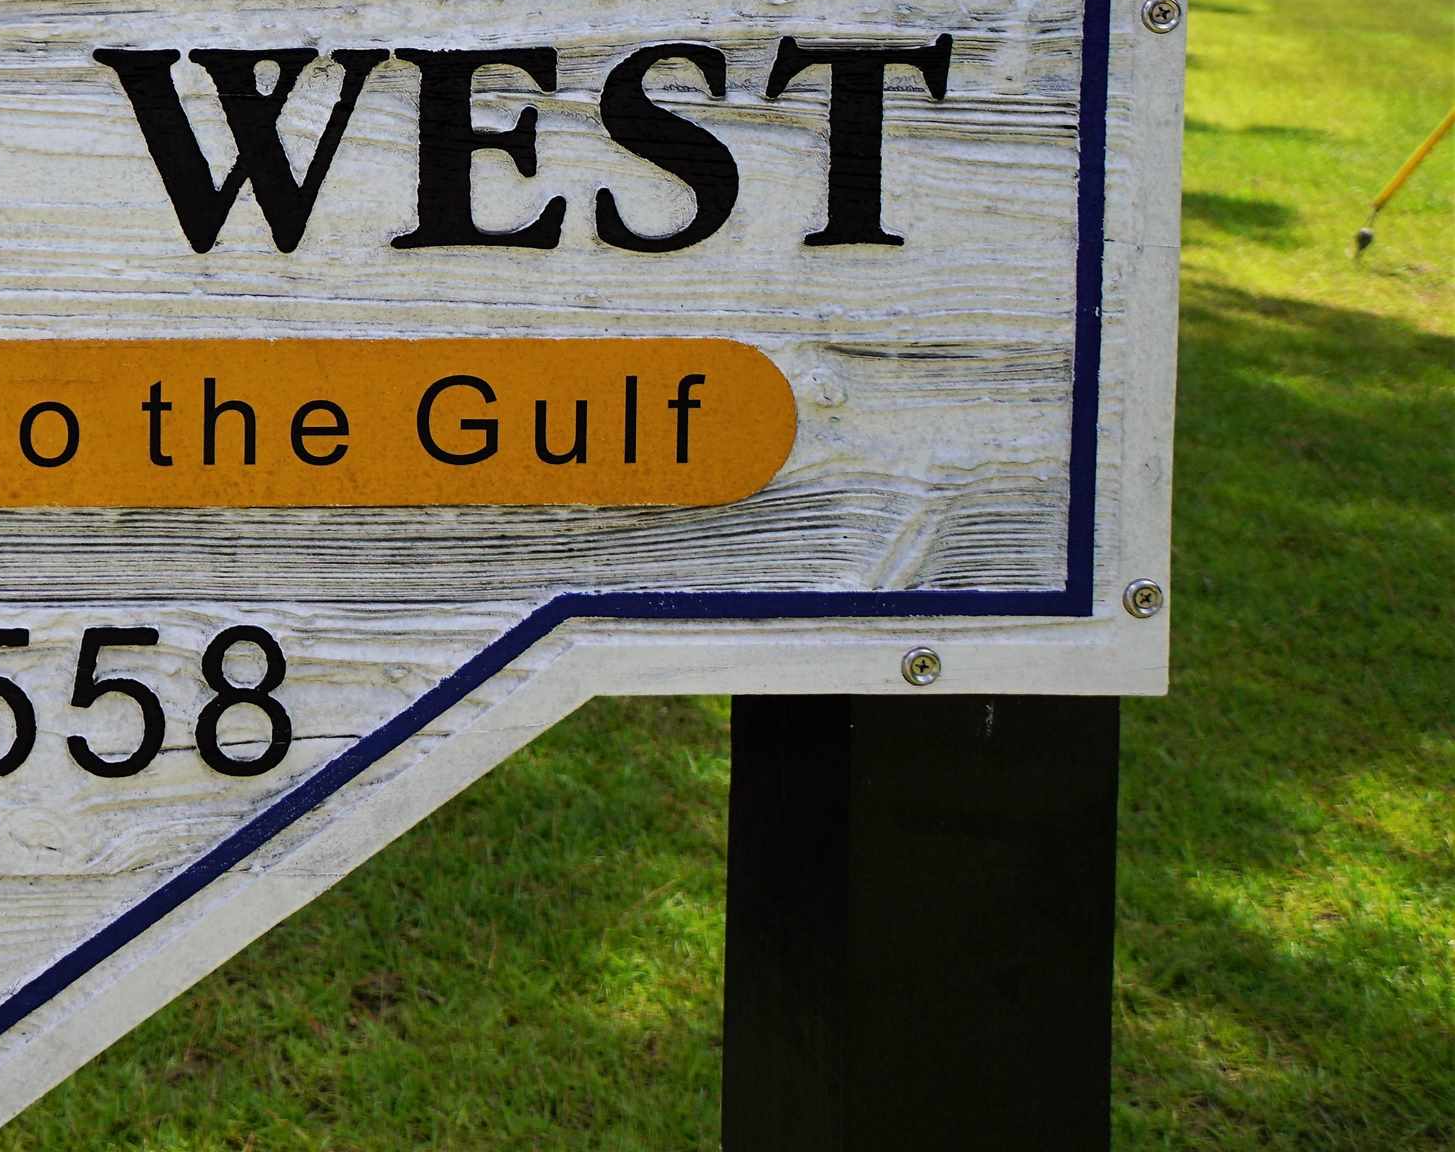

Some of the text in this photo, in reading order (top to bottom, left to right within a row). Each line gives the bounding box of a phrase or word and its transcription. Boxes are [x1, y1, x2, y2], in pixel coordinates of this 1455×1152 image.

[96, 34, 951, 254] WEST
[141, 378, 349, 466] the
[417, 374, 705, 464] Gulf
